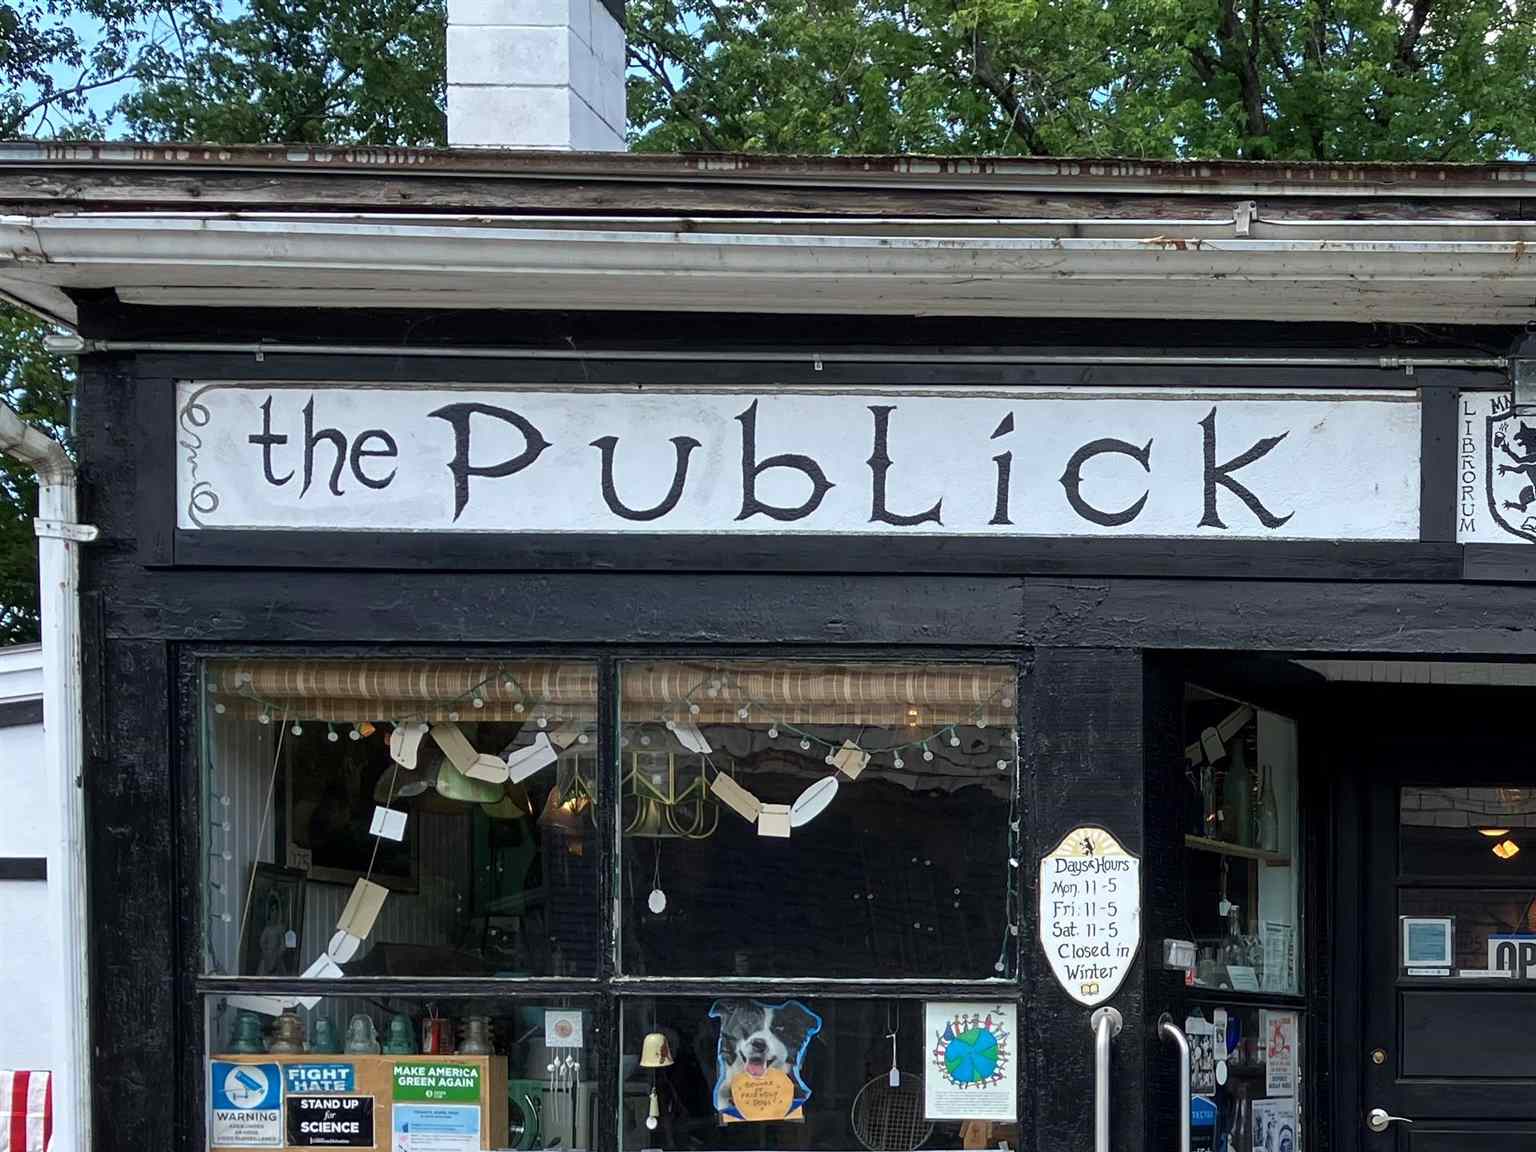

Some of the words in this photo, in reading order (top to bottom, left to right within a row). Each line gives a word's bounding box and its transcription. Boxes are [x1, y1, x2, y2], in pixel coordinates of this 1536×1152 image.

[248, 394, 399, 498] the
[1459, 401, 1477, 533] LIBRORUM
[1057, 942, 1111, 958] Closed
[1116, 944, 1130, 958] in
[1065, 964, 1118, 980] Winter
[288, 1069, 350, 1080] FIGHT
[394, 1067, 426, 1076] MAKE
[428, 1067, 478, 1077] AMERICA
[294, 1080, 346, 1091] HATE
[398, 1077, 436, 1086] GREEN
[438, 1078, 474, 1087] AGAIN
[300, 1099, 340, 1109] STAND
[342, 1099, 359, 1109] UP
[216, 1112, 277, 1121] WARNING
[324, 1110, 336, 1120] for
[300, 1122, 359, 1133] SCIENCE
